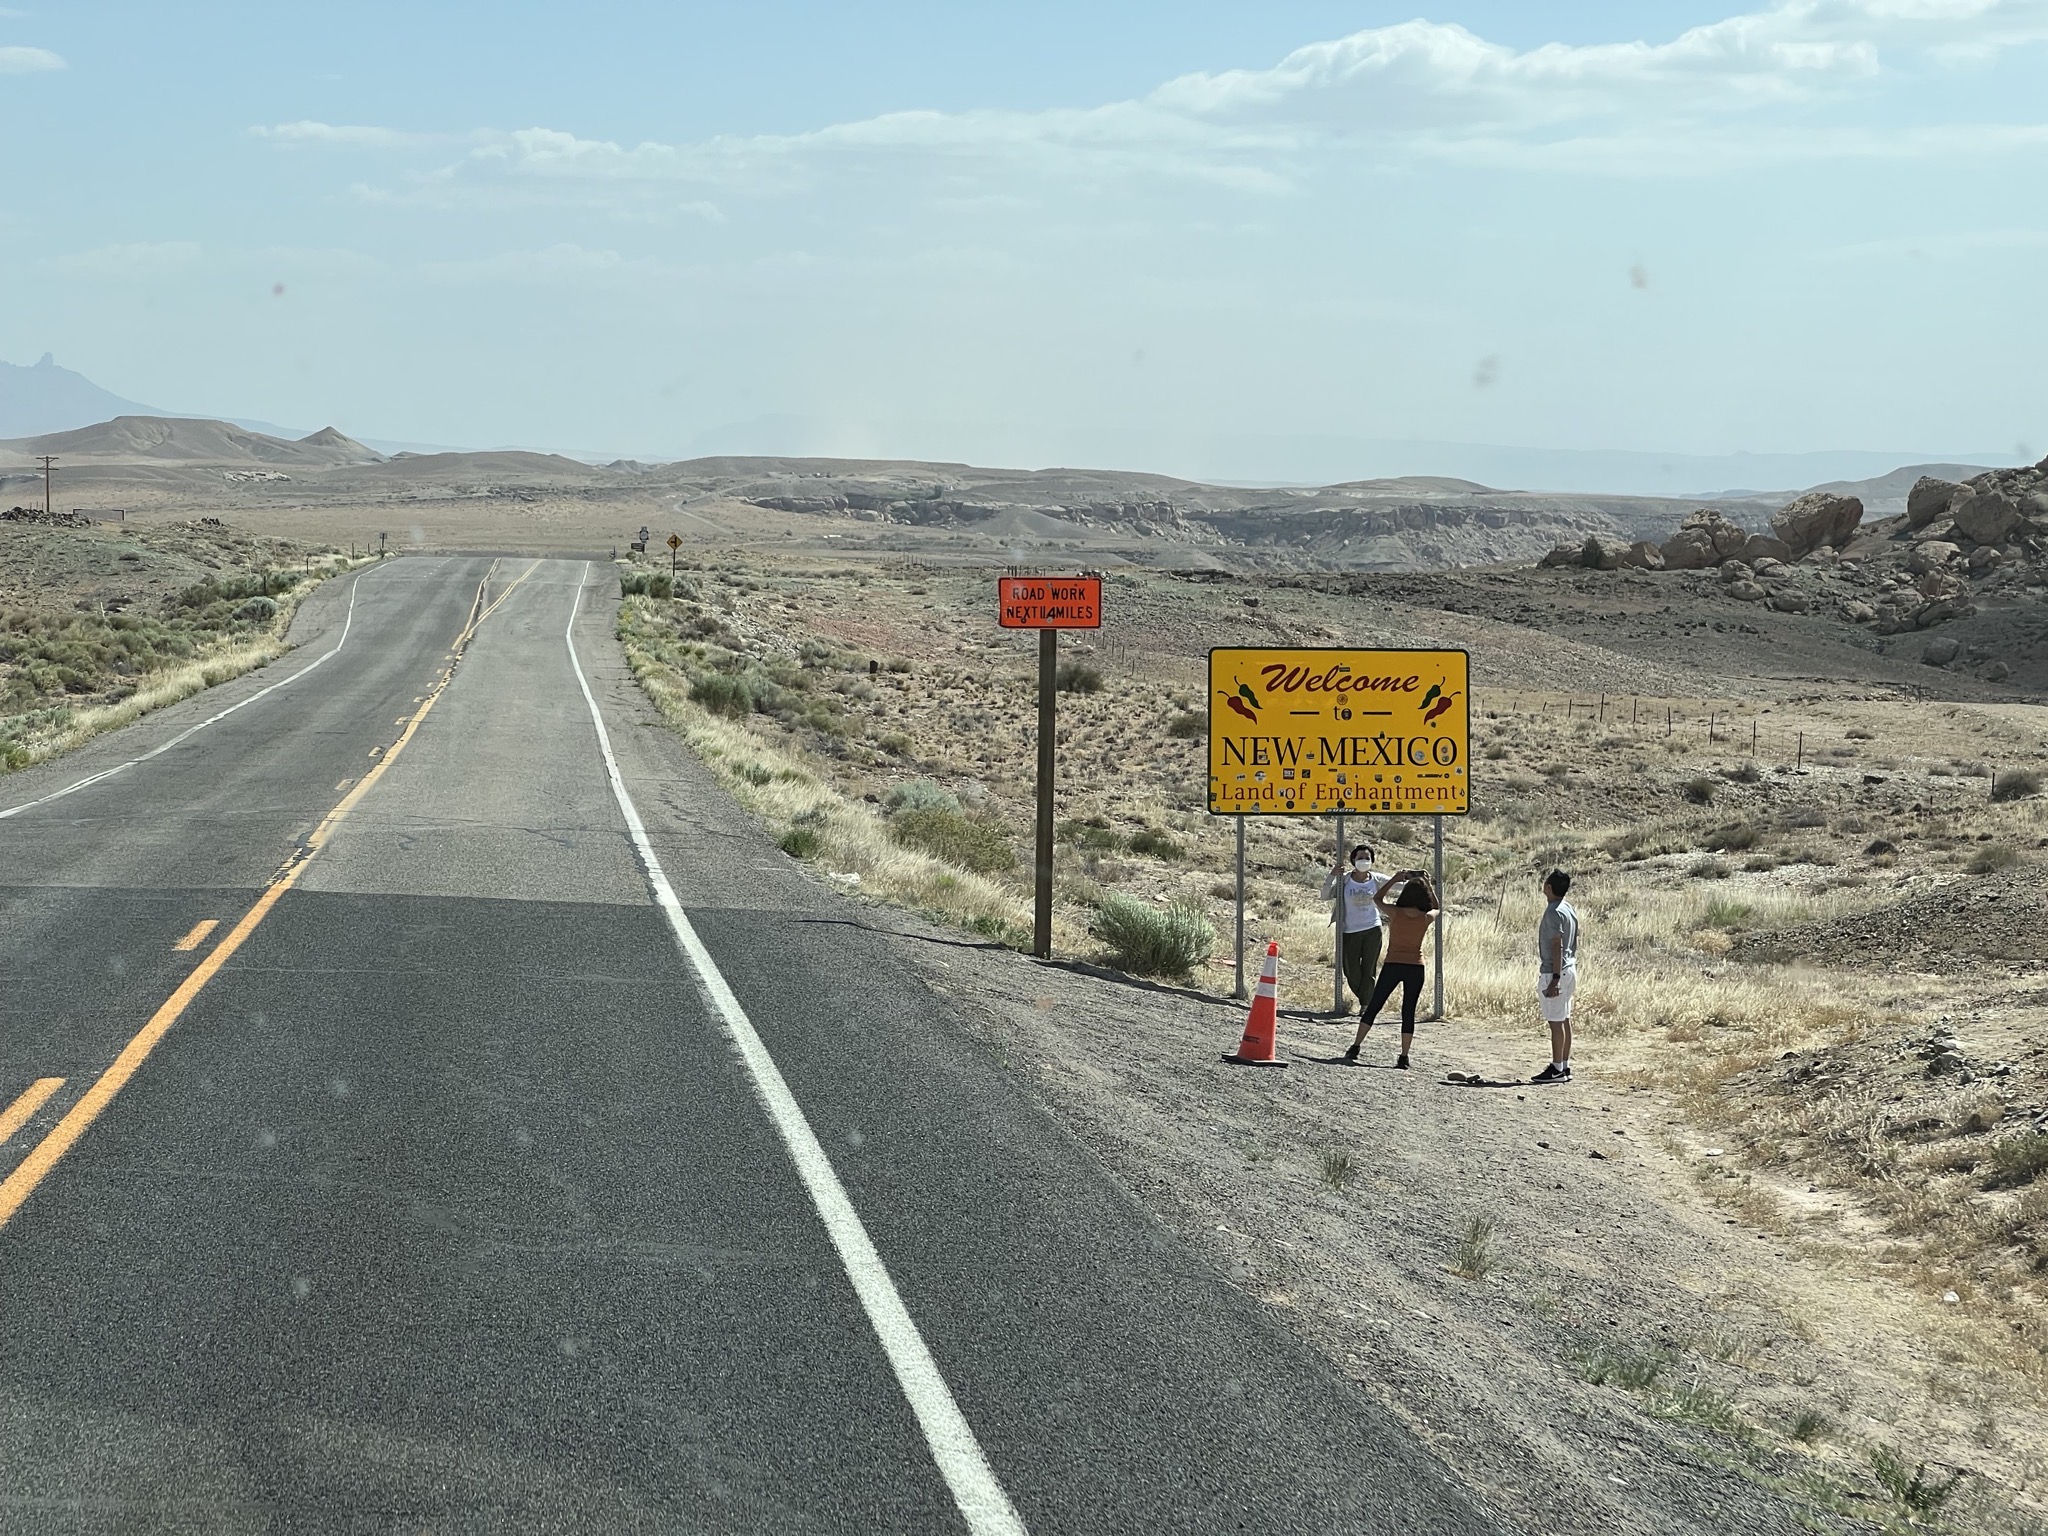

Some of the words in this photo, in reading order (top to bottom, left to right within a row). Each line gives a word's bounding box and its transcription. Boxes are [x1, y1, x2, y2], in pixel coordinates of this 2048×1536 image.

[1013, 587, 1044, 600] ROAD
[1051, 587, 1085, 600] WORK
[1007, 606, 1037, 618] NEXT
[1056, 606, 1092, 618] MILES
[1261, 664, 1419, 692] Welcome
[1221, 737, 1306, 766] NEW
[1318, 736, 1457, 766] MEXICO
[1222, 782, 1275, 800] Land
[1285, 782, 1307, 800] of
[1316, 782, 1457, 800] Enchantment
